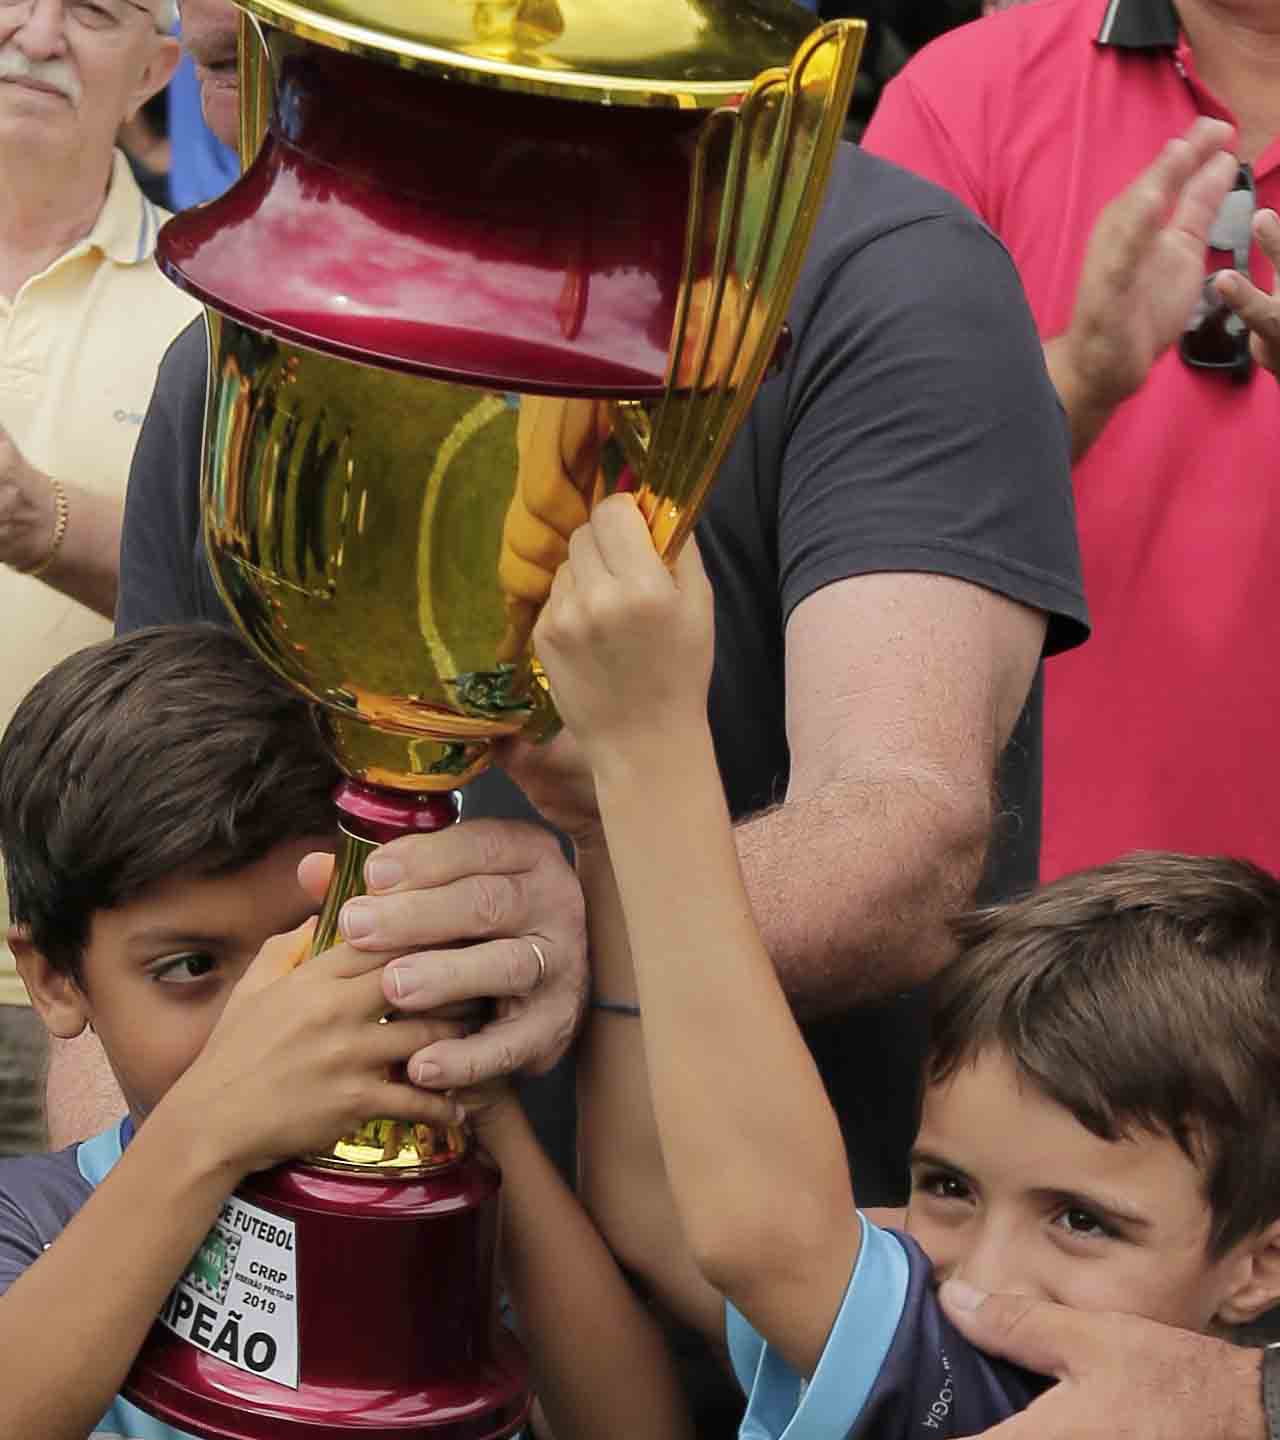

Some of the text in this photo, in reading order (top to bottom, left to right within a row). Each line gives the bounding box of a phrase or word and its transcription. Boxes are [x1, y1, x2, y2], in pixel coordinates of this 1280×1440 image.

[233, 1210, 295, 1252] FUTEBOL
[249, 1261, 288, 1284] CRRP
[242, 1291, 277, 1315] 2019
